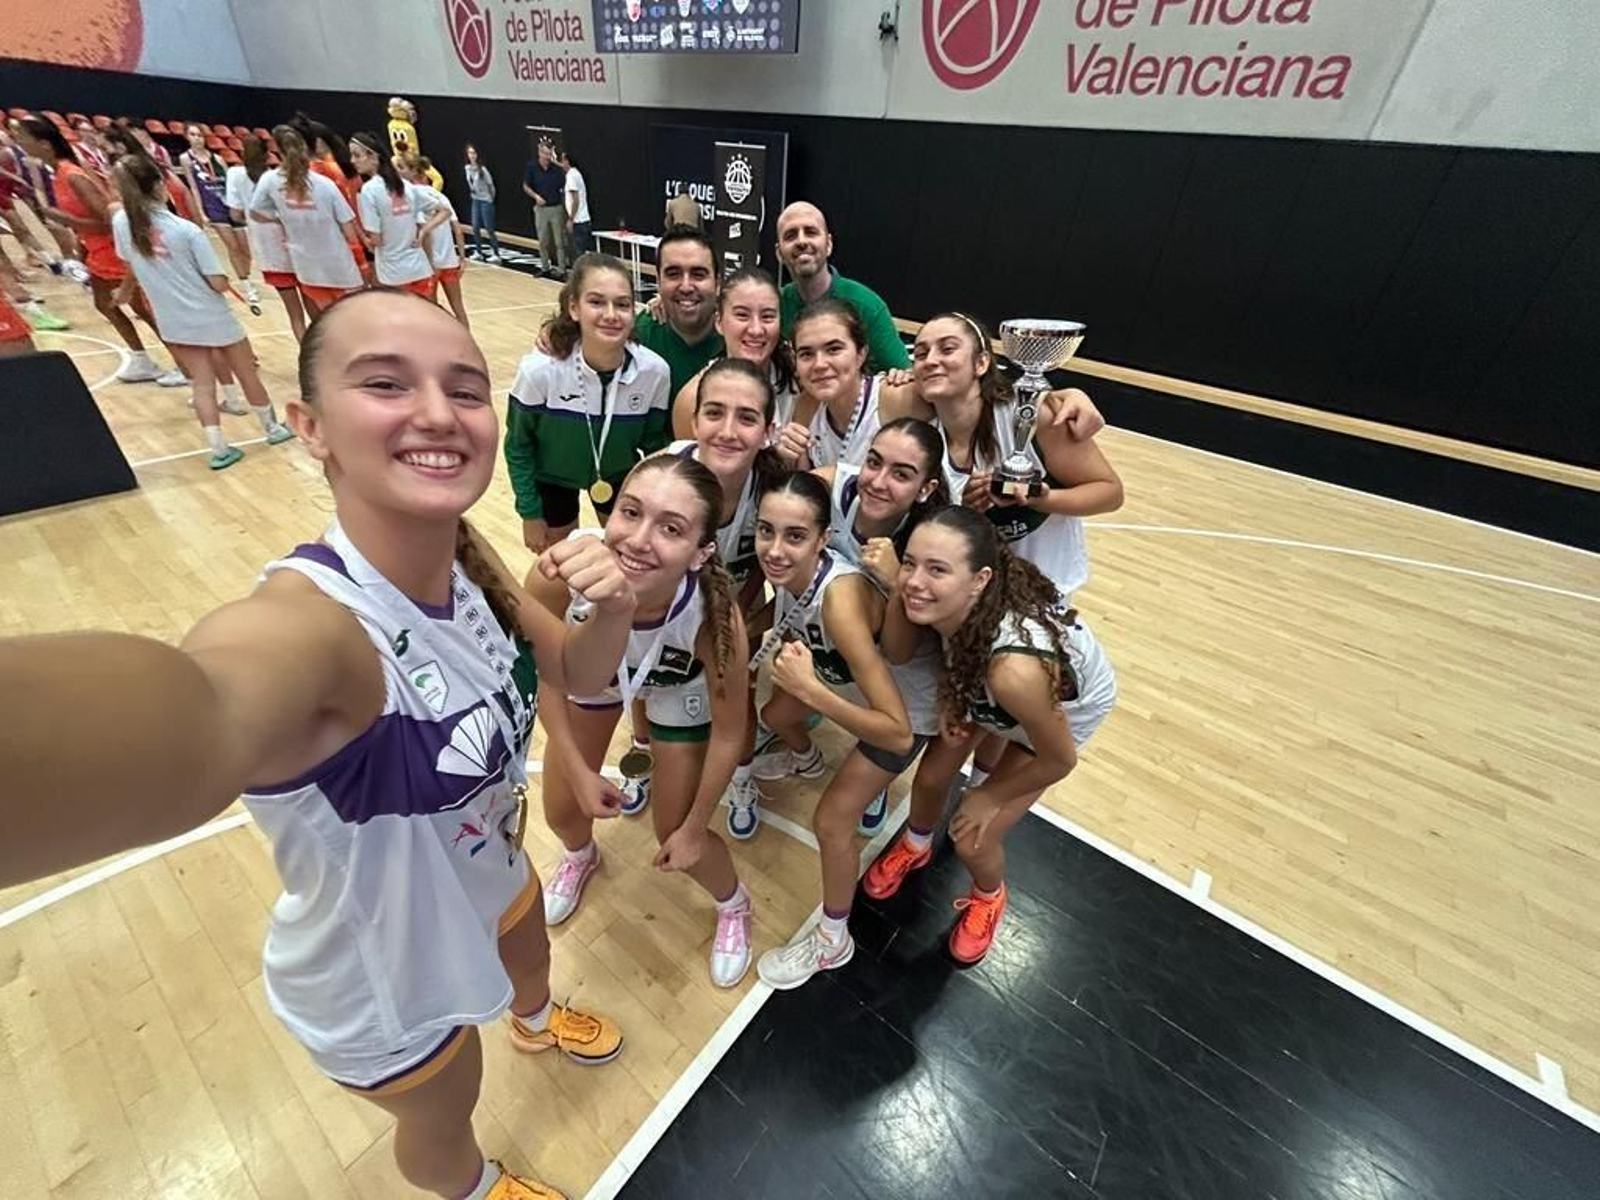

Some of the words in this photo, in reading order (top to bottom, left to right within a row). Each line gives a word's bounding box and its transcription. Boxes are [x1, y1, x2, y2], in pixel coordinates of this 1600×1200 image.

[505, 11, 528, 42] de
[530, 9, 584, 42] Pilota
[507, 49, 606, 83] Valenciana
[1066, 41, 1352, 100] Valenciana
